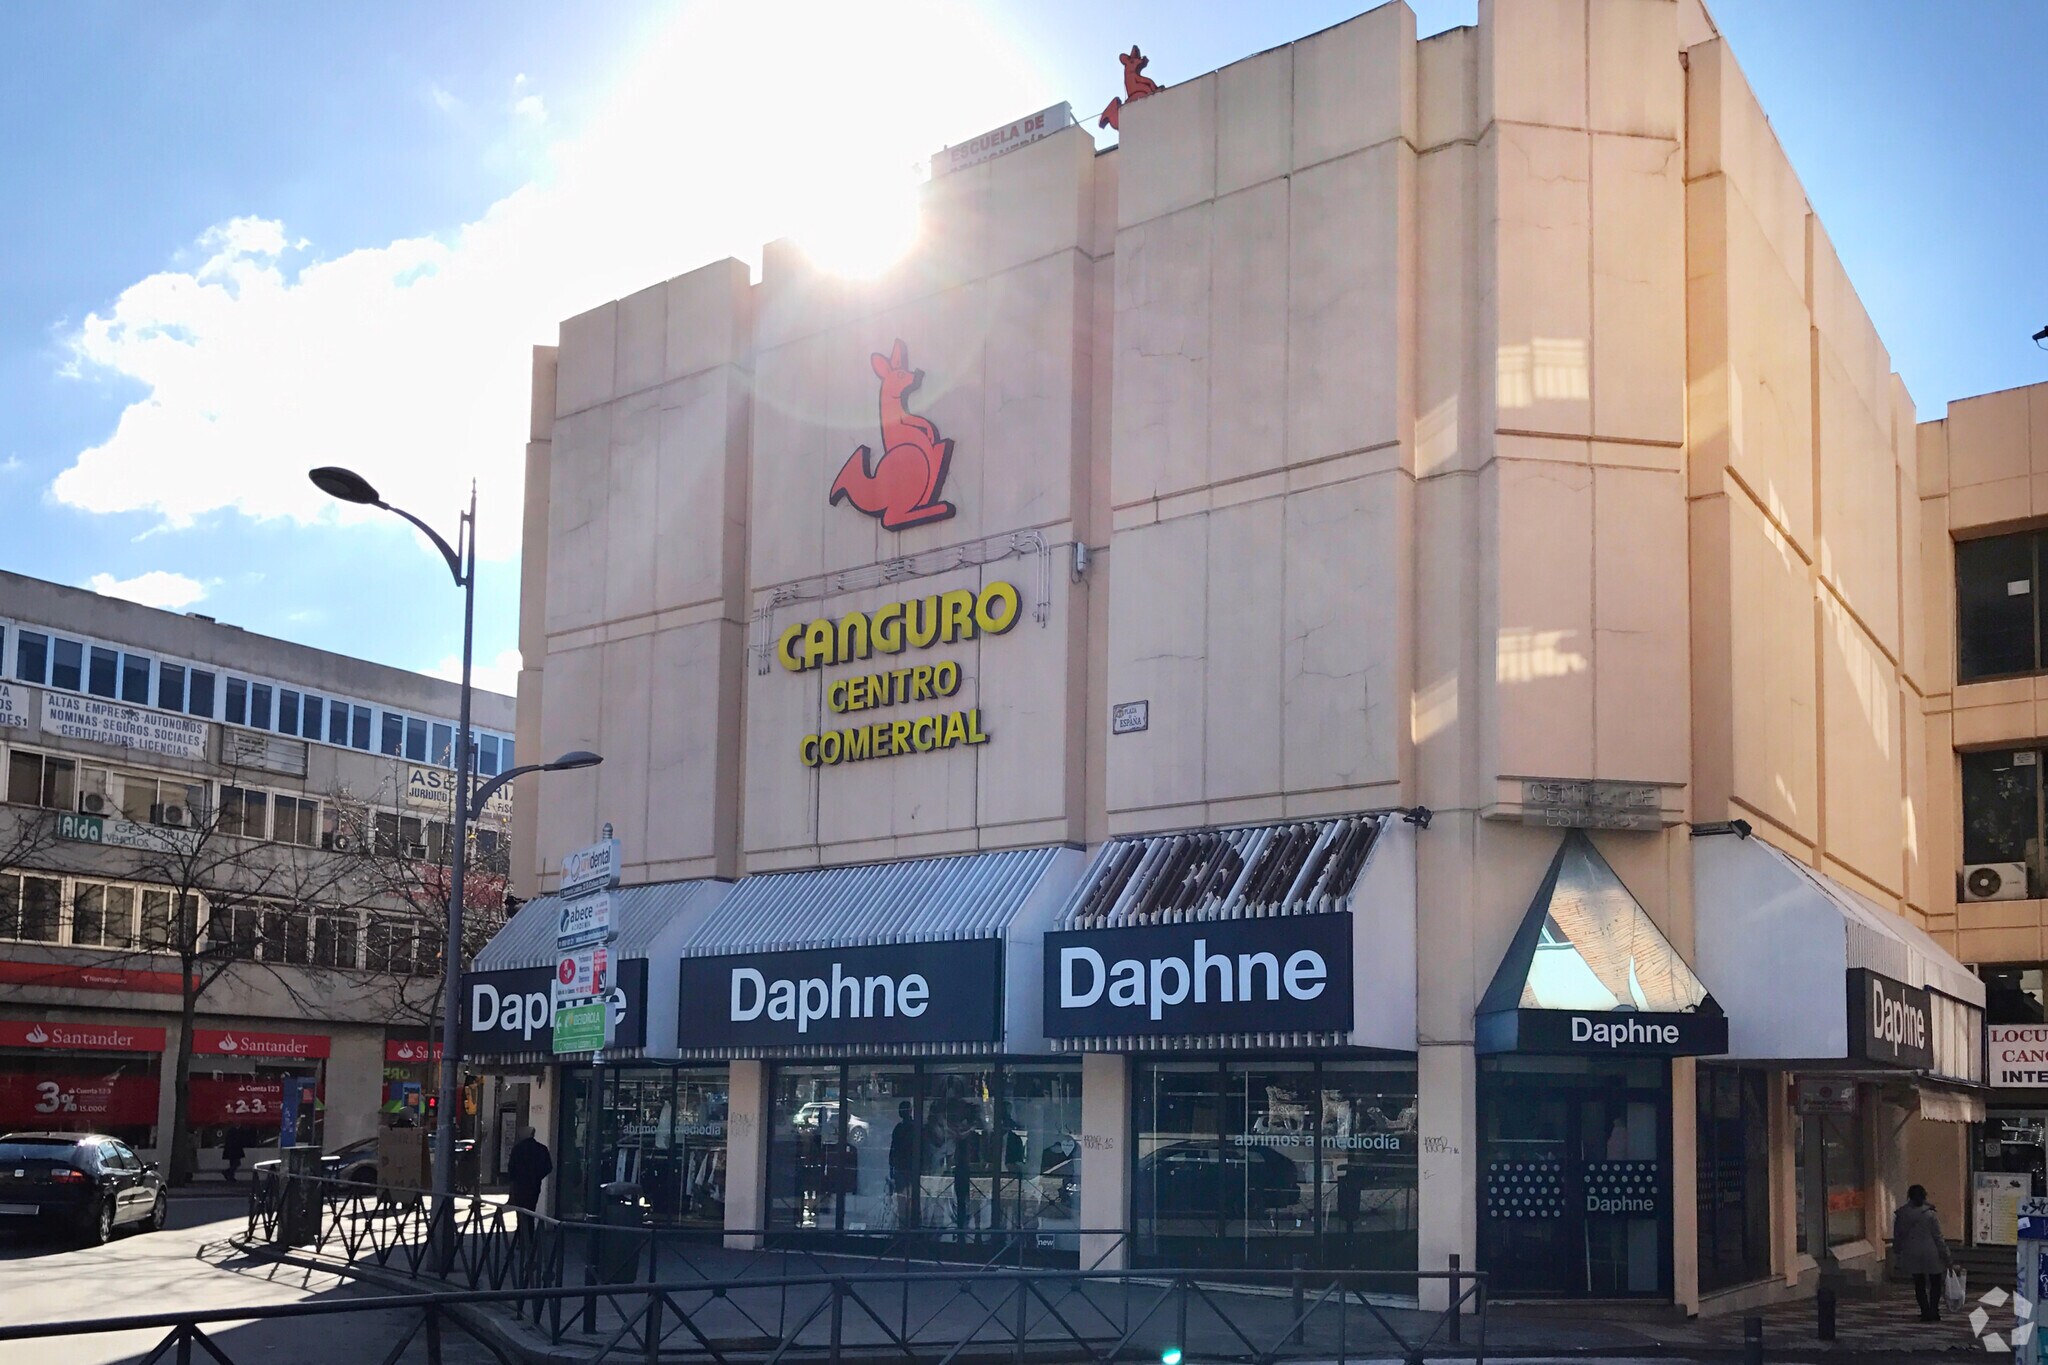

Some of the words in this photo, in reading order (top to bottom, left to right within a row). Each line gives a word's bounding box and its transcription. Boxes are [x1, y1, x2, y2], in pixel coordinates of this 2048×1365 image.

[950, 125, 1020, 162] ESCUELA
[1024, 114, 1045, 134] DE
[778, 581, 1021, 672] CANGURO
[827, 660, 962, 713] CENTRO
[49, 695, 80, 711] ALTAS
[800, 709, 989, 767] COMERCIAL
[63, 816, 98, 841] Alda
[570, 906, 593, 923] abece
[1060, 939, 1327, 1021] Daphne
[731, 963, 929, 1033] Daphne
[472, 979, 627, 1041] Dape
[1873, 979, 1925, 1056] Daphne
[52, 1028, 134, 1046] Santander
[1571, 1017, 1679, 1047] Daphne
[1991, 1029, 2048, 1043] LOCU
[241, 1037, 308, 1053] Santander
[2002, 1050, 2048, 1063] CAN
[2002, 1071, 2048, 1083] INTE
[623, 1122, 657, 1134] abrimo
[1234, 1130, 1300, 1147] abrimos
[1305, 1135, 1314, 1147] a
[1321, 1132, 1400, 1150] mediodía
[1587, 1195, 1654, 1214] Daphne
[1038, 1239, 1054, 1247] new
